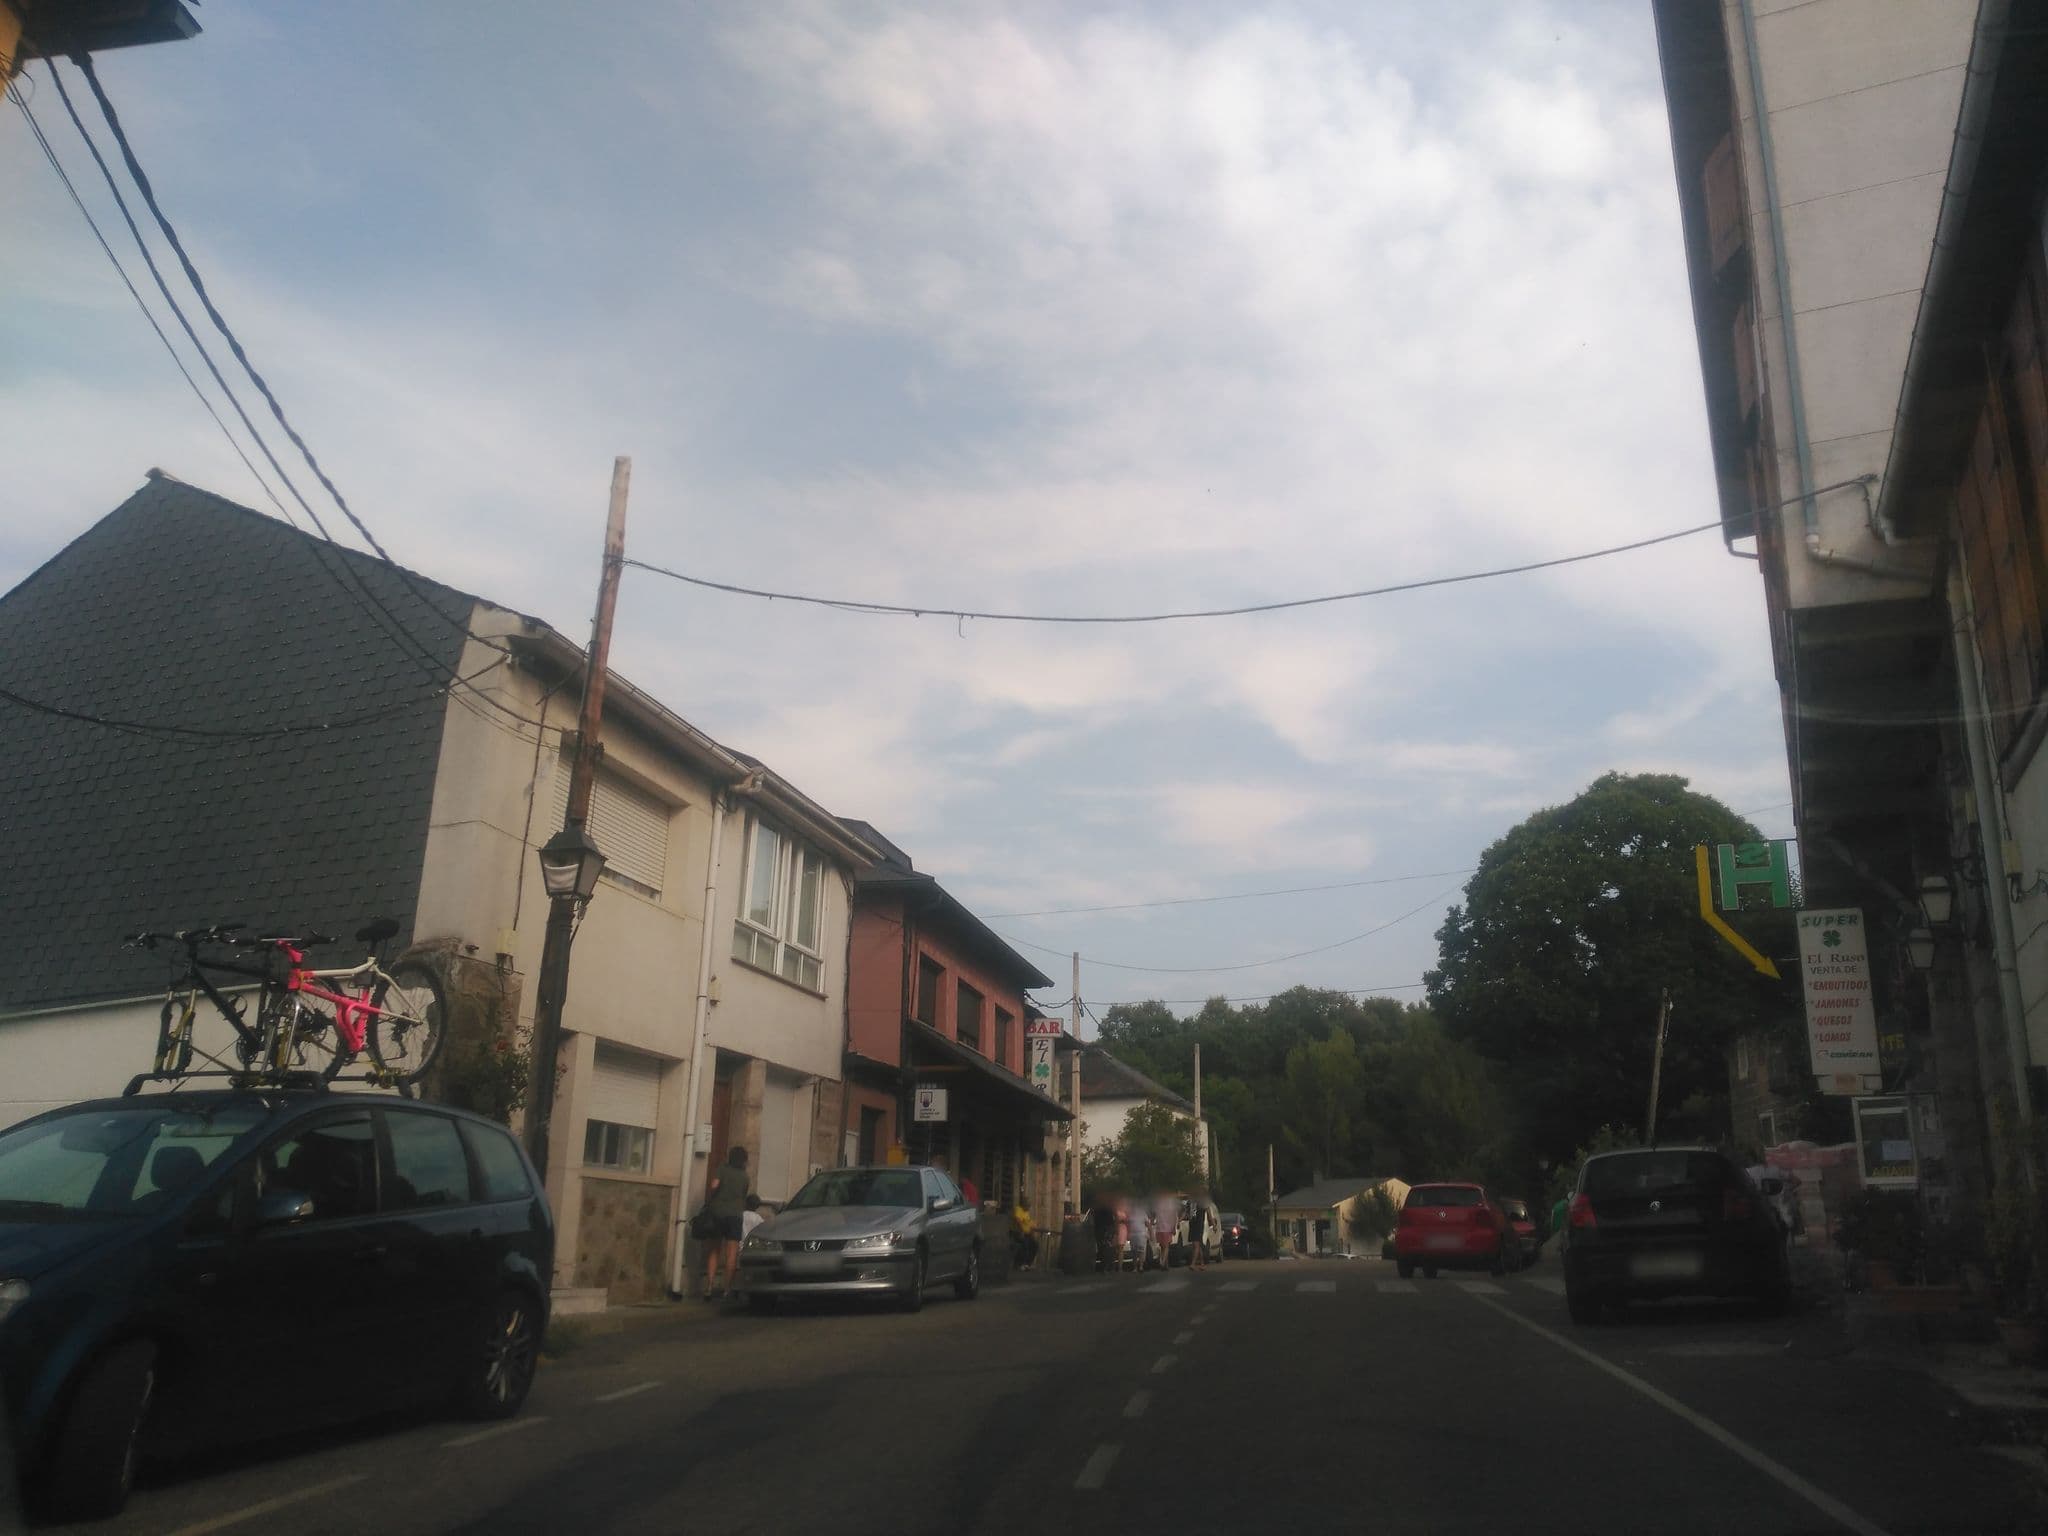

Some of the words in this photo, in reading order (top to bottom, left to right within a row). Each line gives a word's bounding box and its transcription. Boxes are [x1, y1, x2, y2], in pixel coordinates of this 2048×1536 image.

[1801, 914, 1858, 928] SUPER
[1807, 954, 1821, 964] El
[1831, 953, 1865, 963] Ruso
[1810, 966, 1842, 974] VENTA
[1844, 965, 1857, 974] DE
[1815, 998, 1860, 1009] JAMONES
[1816, 1016, 1853, 1026] QUESOS
[1819, 1032, 1852, 1042] LOMOS
